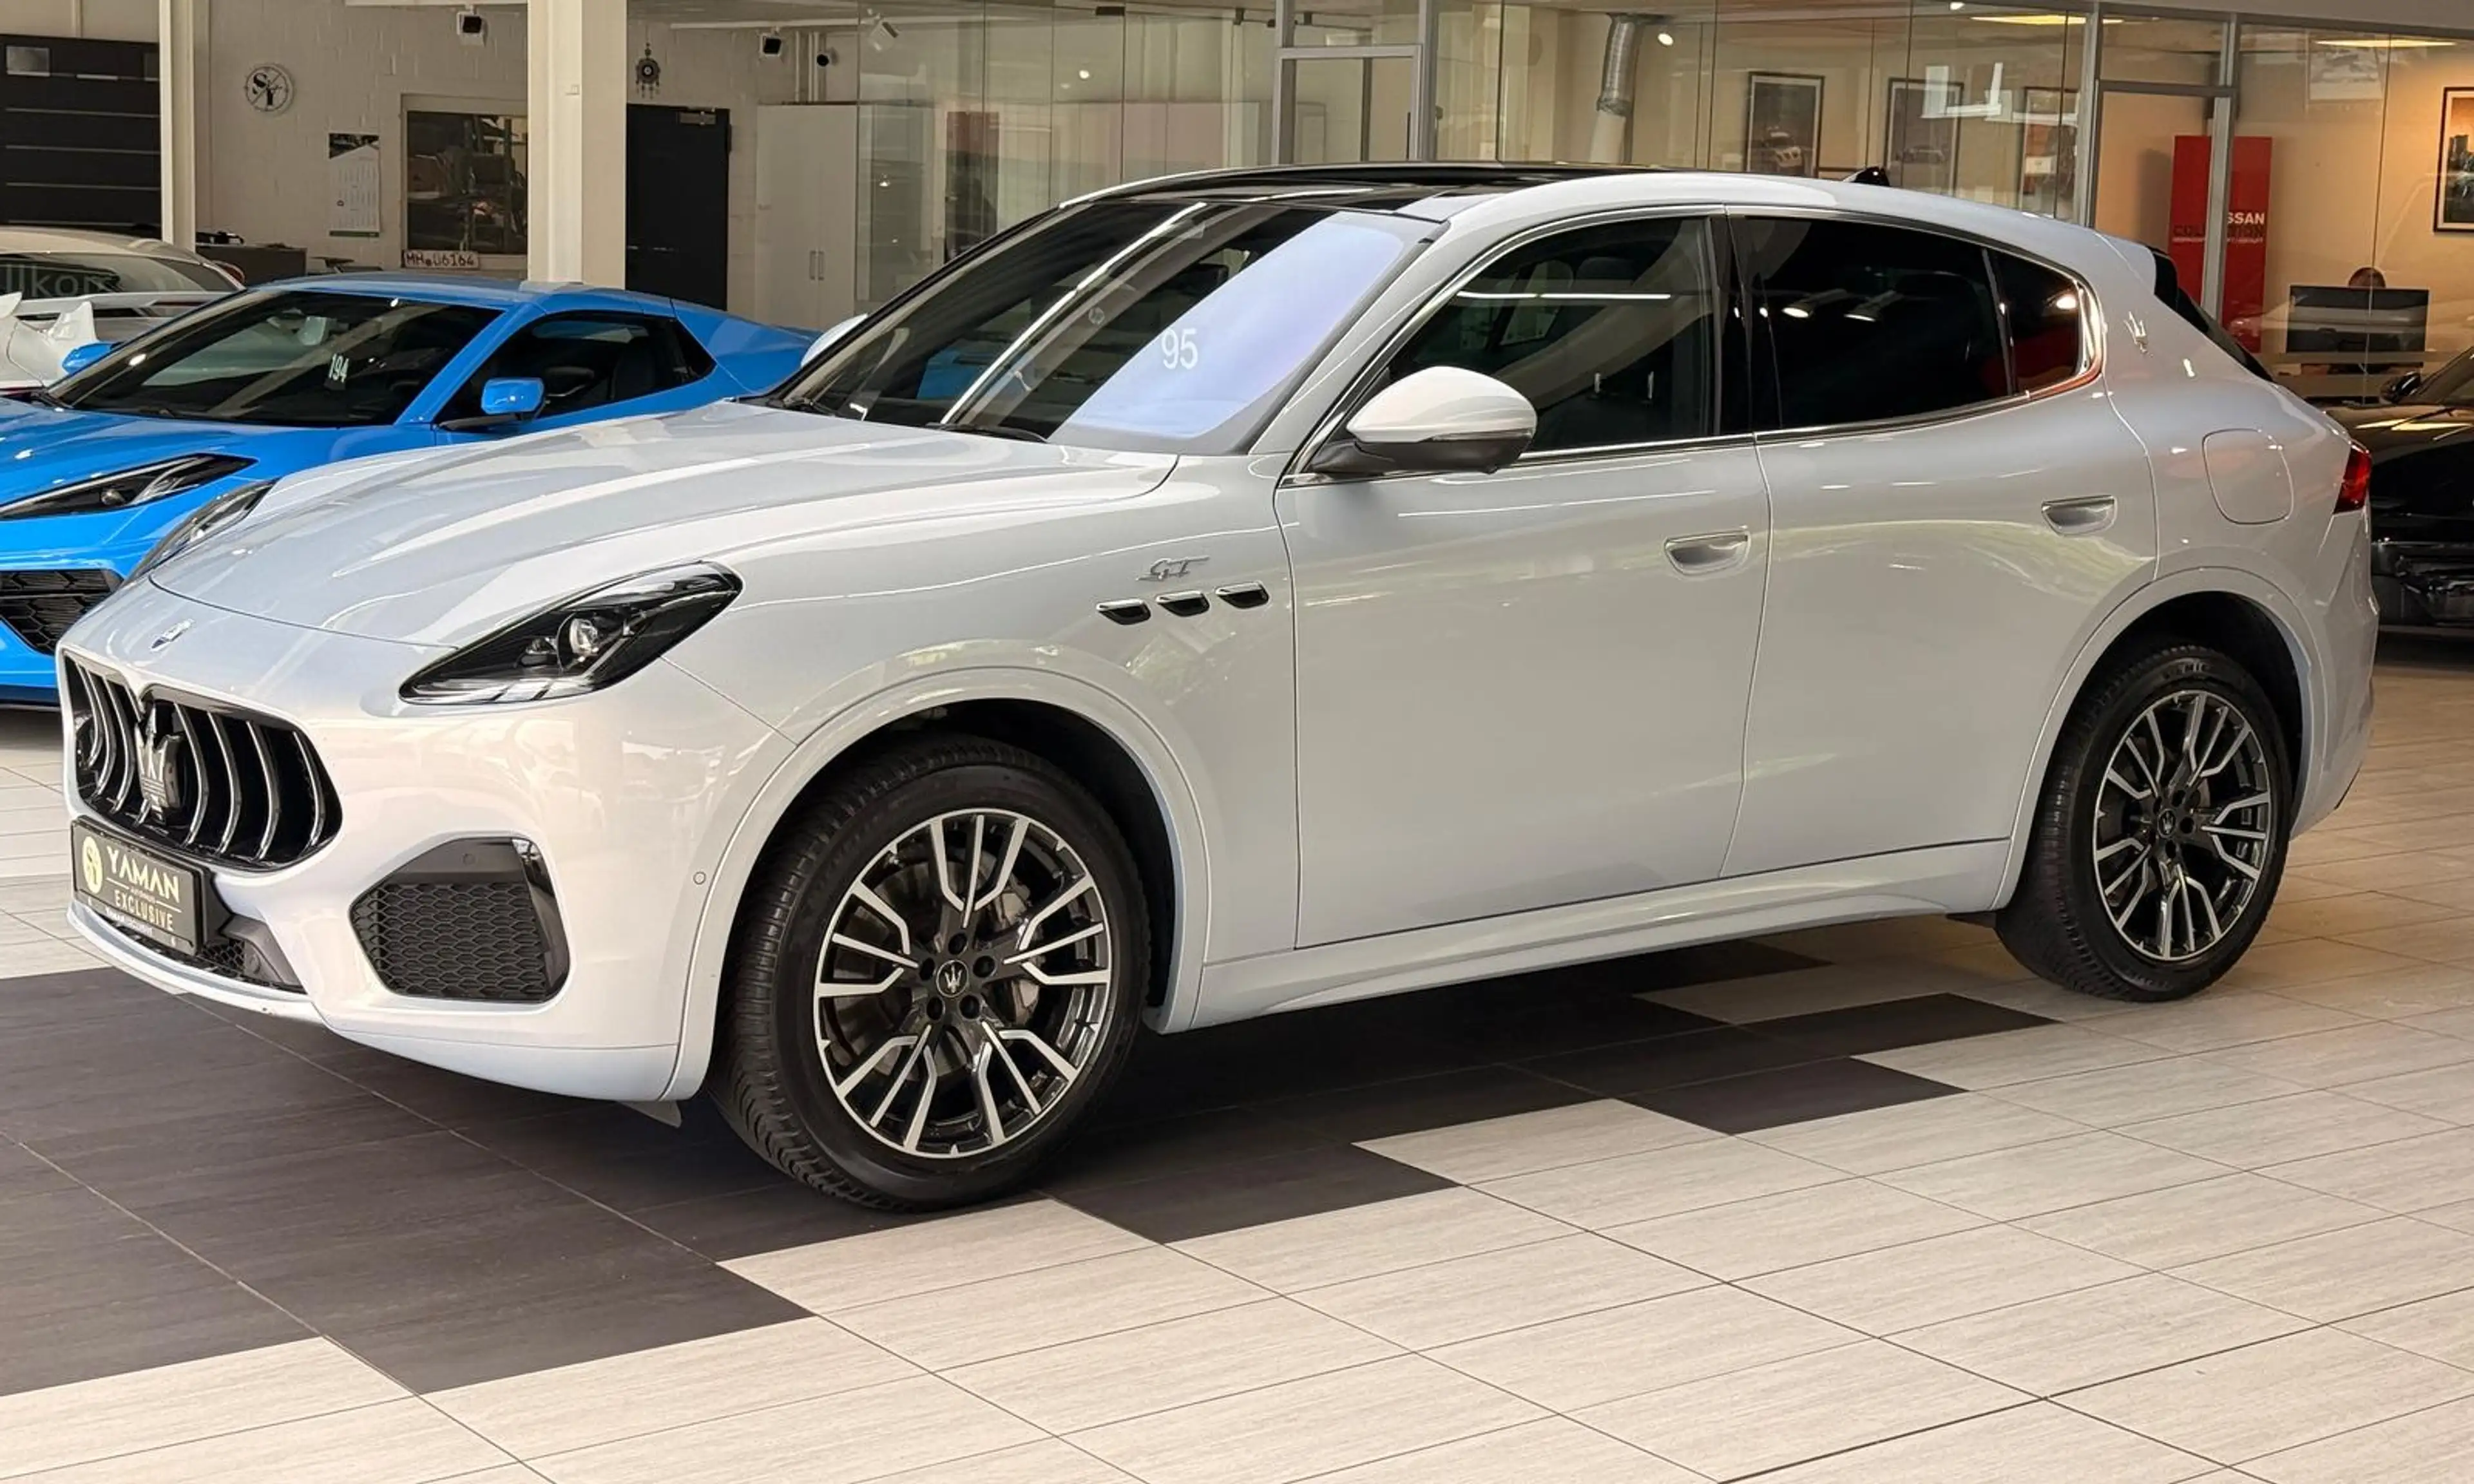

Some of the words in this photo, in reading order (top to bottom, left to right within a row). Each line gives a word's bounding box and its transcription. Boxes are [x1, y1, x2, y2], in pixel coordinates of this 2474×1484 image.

[2227, 211, 2265, 224] SSAN
[329, 353, 349, 383] 194
[1162, 328, 1198, 369] 95
[107, 845, 180, 903] YAMAN
[114, 888, 174, 931] EXCLUSIVE
